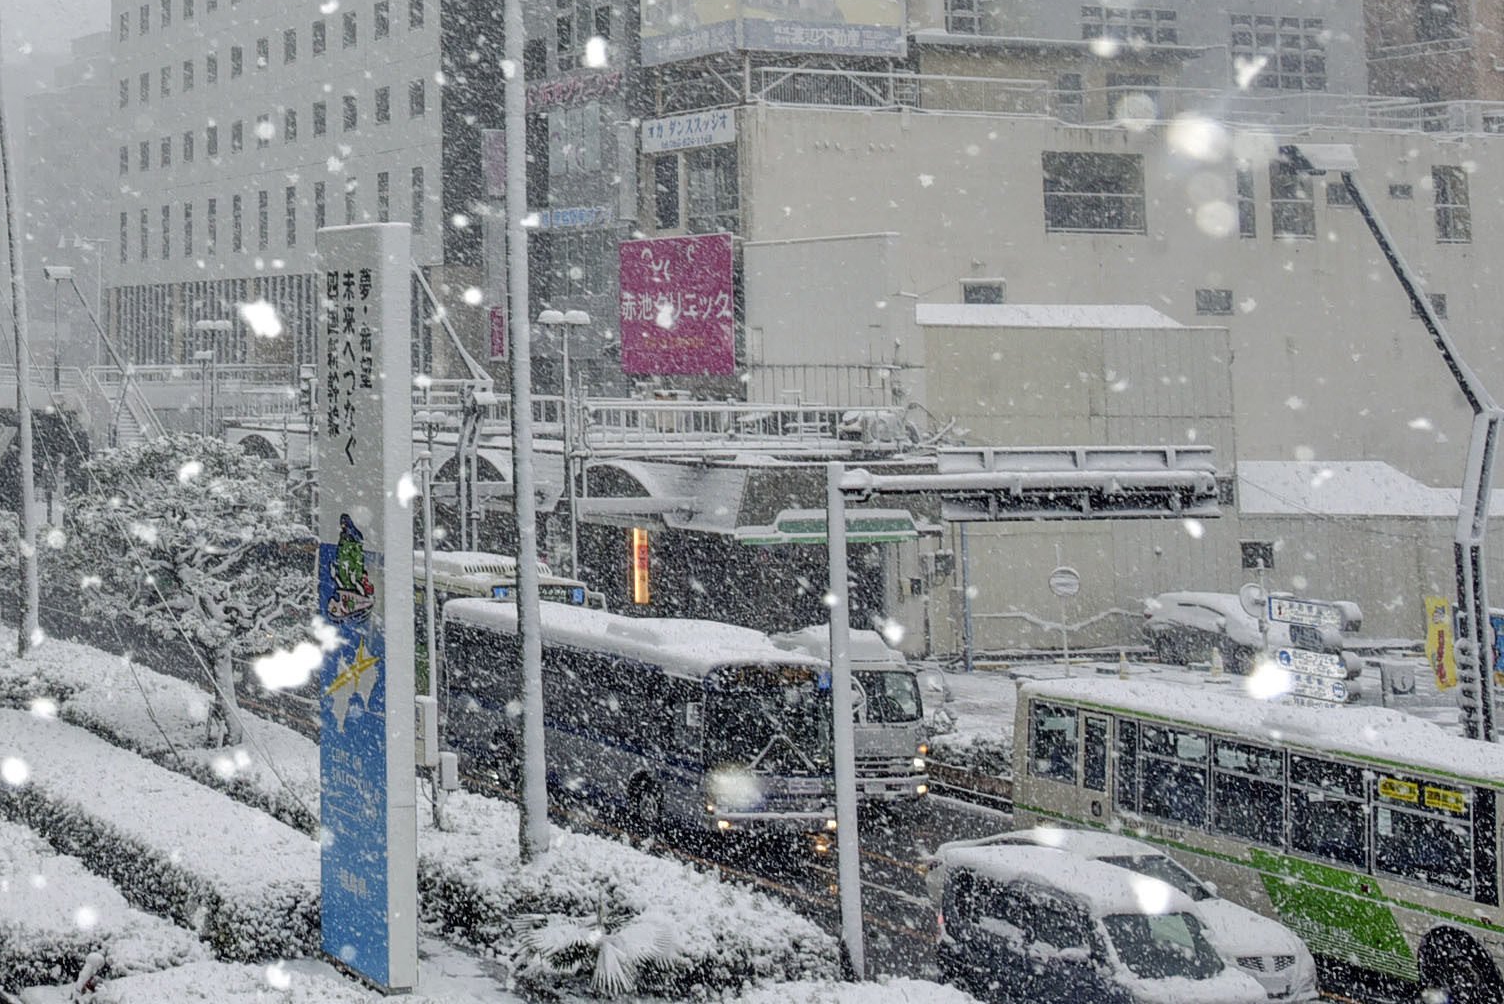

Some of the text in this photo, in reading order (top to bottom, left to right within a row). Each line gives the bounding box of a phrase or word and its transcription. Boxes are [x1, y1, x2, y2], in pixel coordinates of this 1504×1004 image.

[359, 267, 373, 389] 夢・希望
[622, 290, 732, 322] 赤池クリニック
[343, 270, 357, 466] 未来へつなぐ
